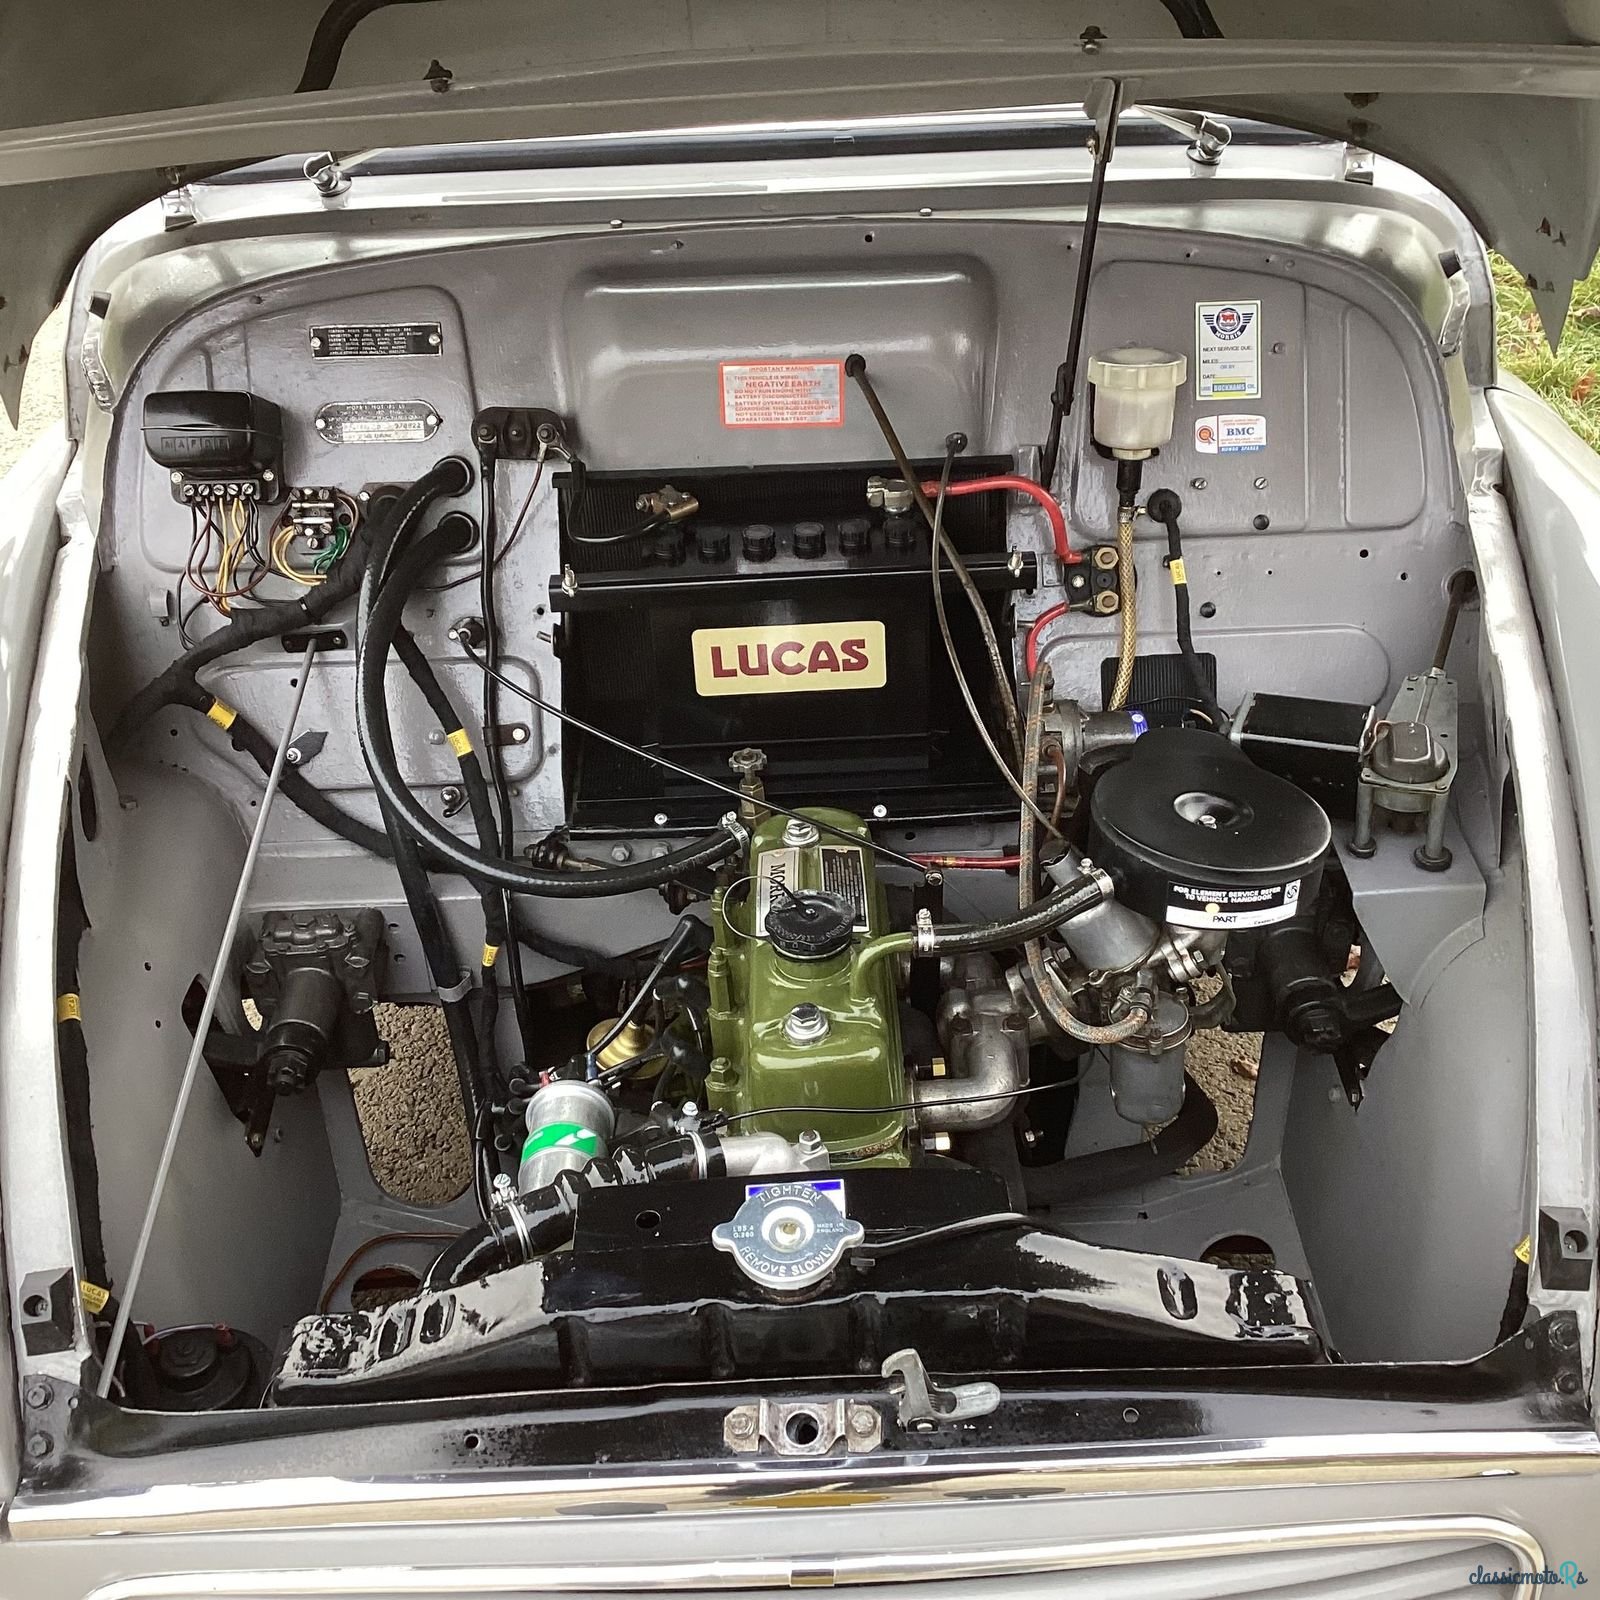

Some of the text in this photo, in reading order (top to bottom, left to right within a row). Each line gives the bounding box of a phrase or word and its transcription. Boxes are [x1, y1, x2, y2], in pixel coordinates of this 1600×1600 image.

[1215, 331, 1242, 341] MORRIS
[1227, 427, 1255, 437] BMC
[710, 638, 869, 678] LUCAS
[1173, 885, 1281, 898] FOR ELEMENT SERVICE REFER
[1196, 895, 1229, 903] VEHICLE
[1230, 893, 1273, 903] HANDBOOK
[1212, 915, 1238, 923] PART
[756, 1184, 822, 1203] TIGHTEN
[739, 1244, 834, 1277] REMOVE SLOWLY
[82, 1284, 106, 1299] LUCAS
